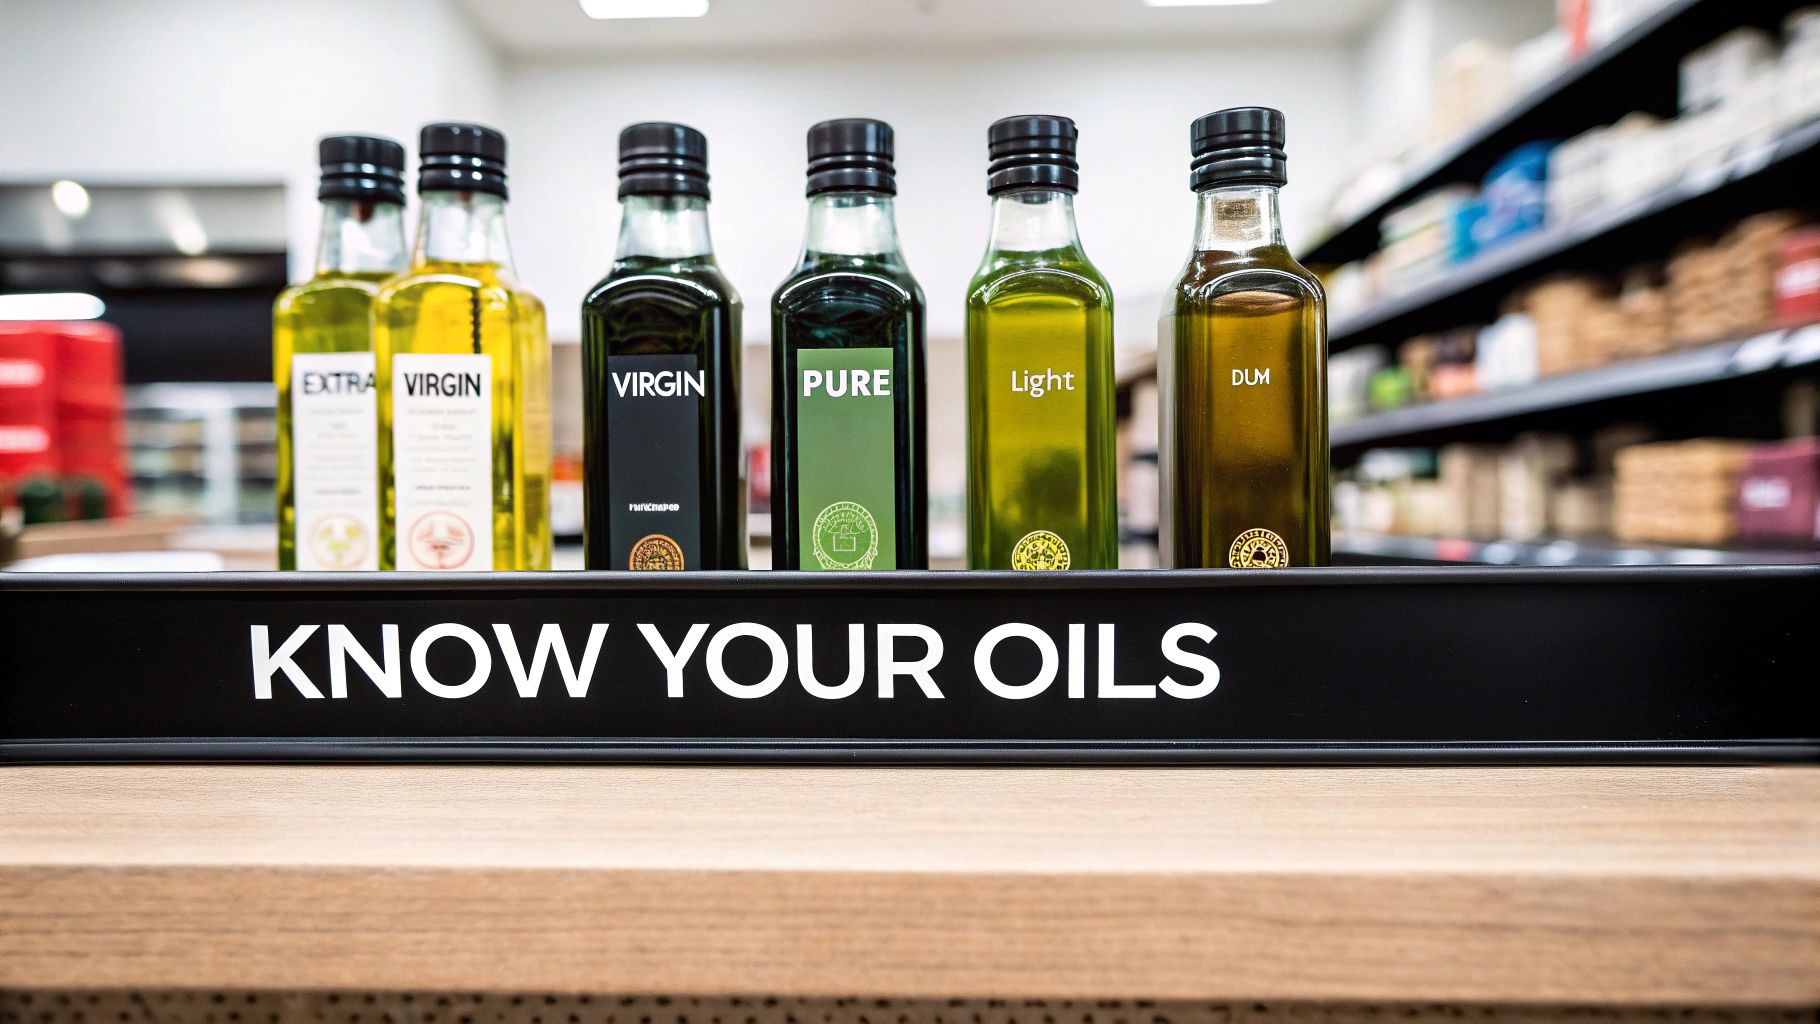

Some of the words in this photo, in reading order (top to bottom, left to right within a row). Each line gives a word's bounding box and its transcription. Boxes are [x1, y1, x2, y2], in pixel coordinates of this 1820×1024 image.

[303, 371, 376, 395] EXTRA
[404, 372, 481, 397] VIRGIN
[611, 369, 705, 398] VIRGIN
[803, 369, 891, 398] PURE
[1011, 368, 1075, 398] Light
[1231, 368, 1270, 386] DUM
[250, 622, 610, 700] KNOW
[636, 622, 946, 700] YOUR
[973, 622, 1221, 700] OILS
